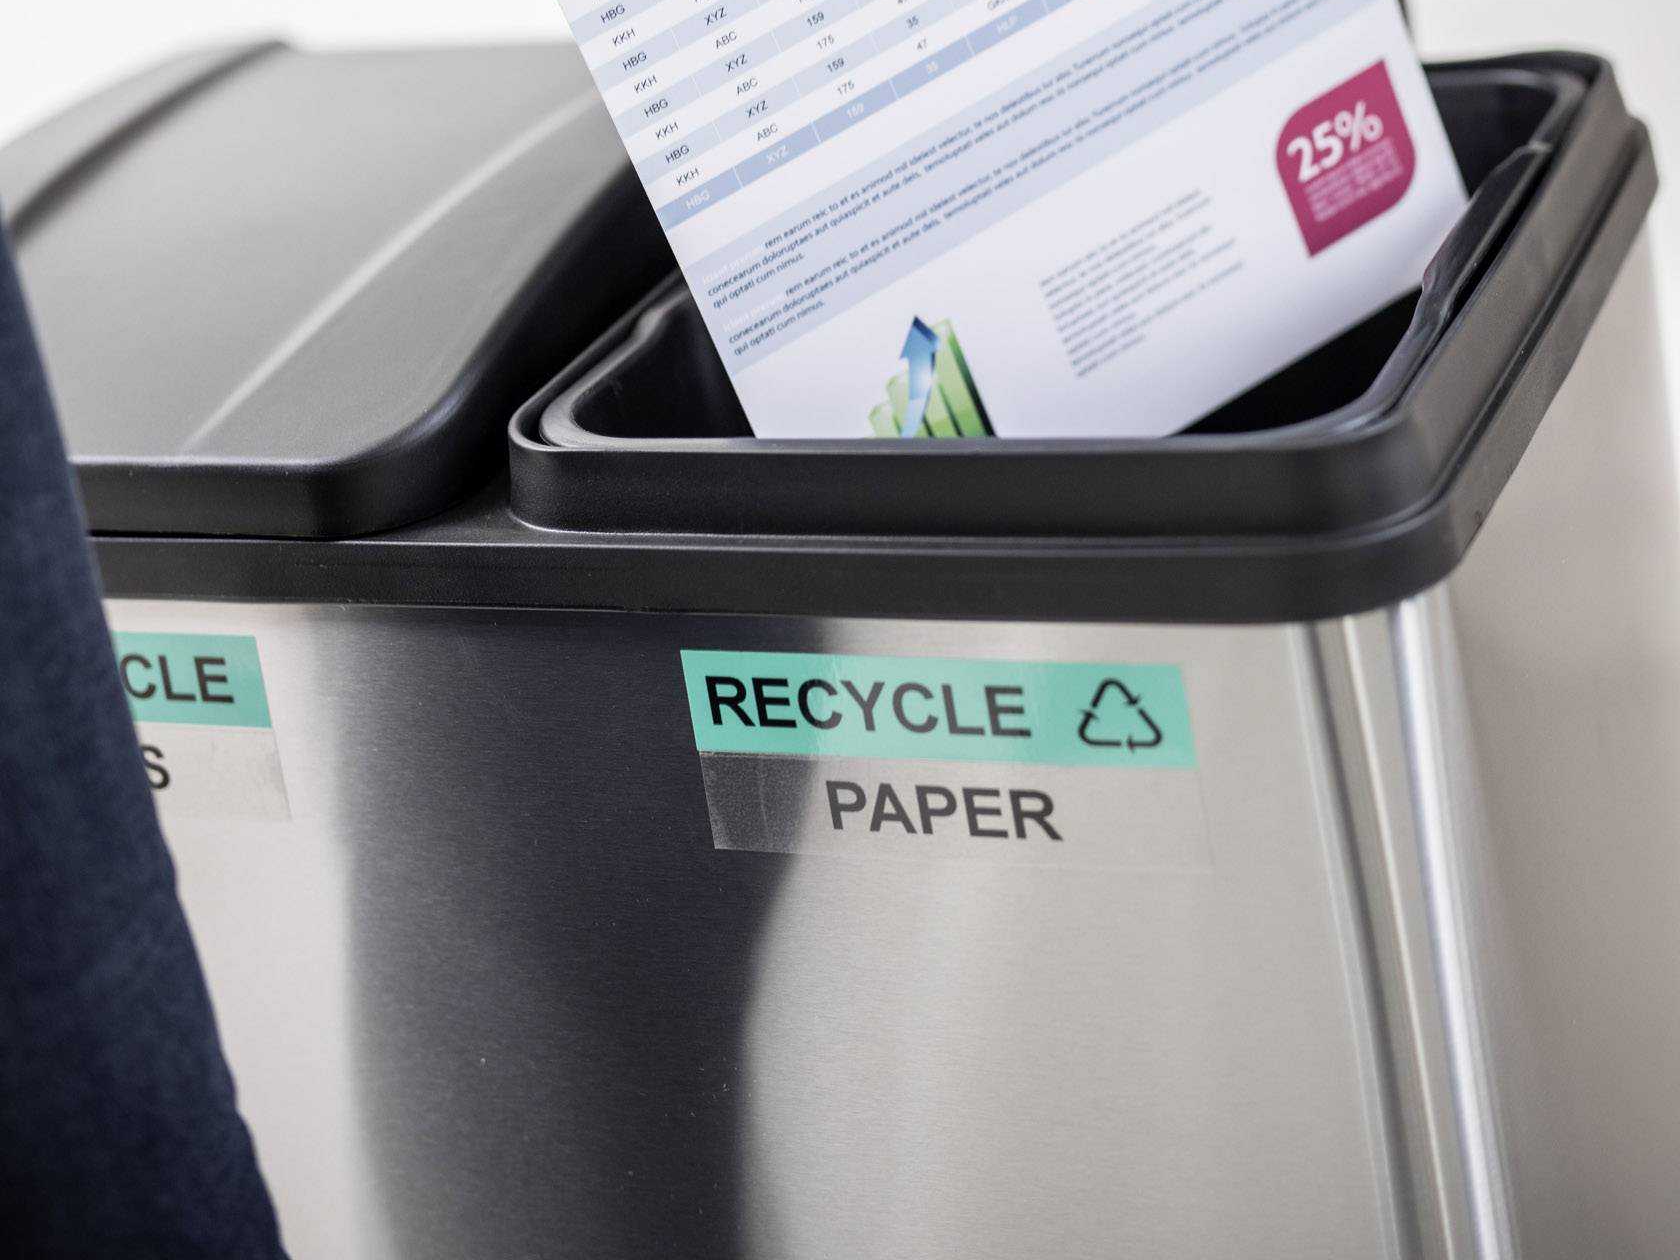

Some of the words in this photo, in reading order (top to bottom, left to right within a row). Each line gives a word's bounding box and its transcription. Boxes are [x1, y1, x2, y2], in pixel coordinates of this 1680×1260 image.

[621, 51, 648, 71] HBG
[704, 6, 728, 27] XYZ
[633, 74, 658, 94] KKH
[715, 30, 738, 50] ABC
[1286, 100, 1384, 183] 25%
[705, 675, 1032, 738] RECYCLE
[826, 780, 1063, 841] PAPER
